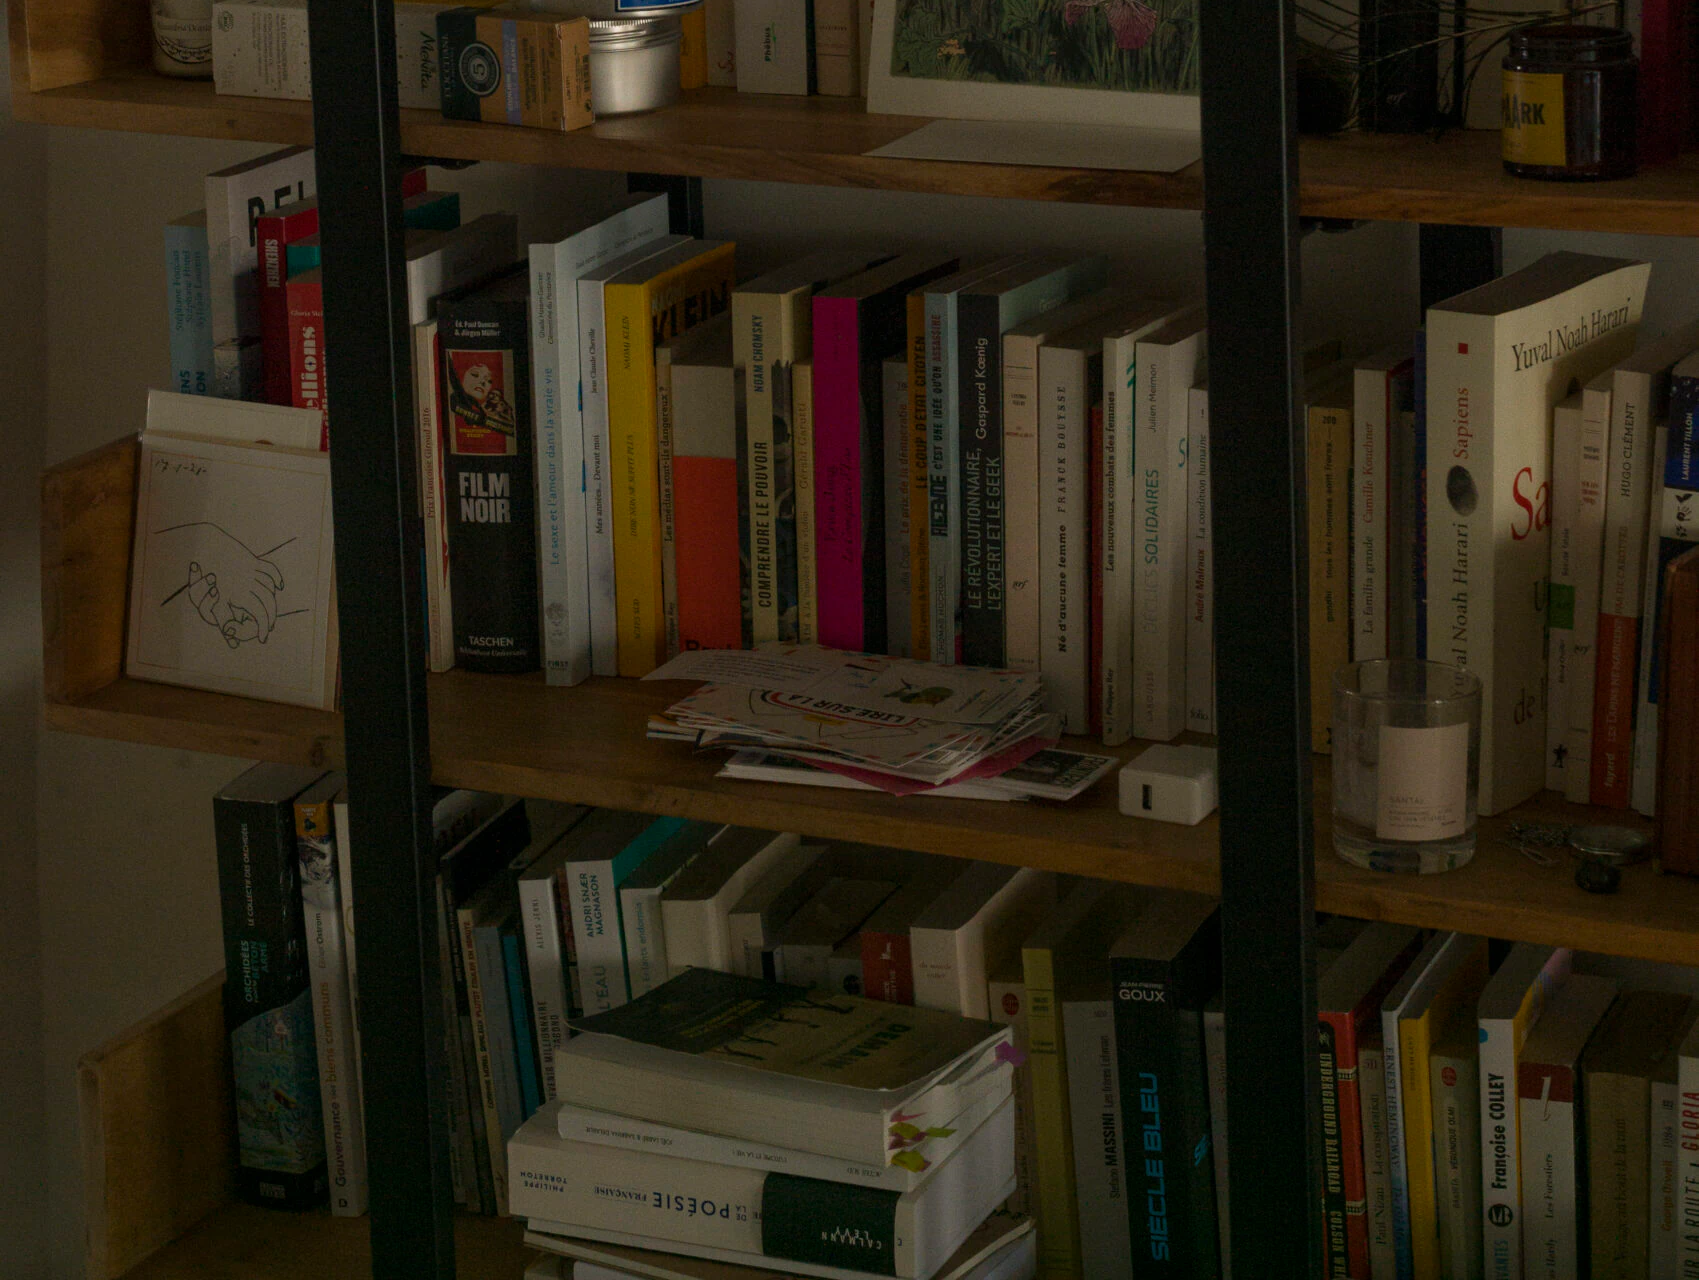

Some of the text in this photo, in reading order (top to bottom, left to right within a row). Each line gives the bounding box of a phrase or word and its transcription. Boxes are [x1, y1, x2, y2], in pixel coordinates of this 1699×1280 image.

[1512, 297, 1632, 372] Yuval Noah Harari
[542, 368, 553, 385] vie
[543, 387, 554, 416] vraie
[975, 382, 989, 439] Gaspard
[1148, 405, 1157, 433] Julien
[544, 418, 555, 429] la
[544, 432, 556, 458] dans
[752, 315, 772, 607] COMPRENDRE LE POUVOIR NOAM CHOMSKY
[1621, 403, 1635, 497] HUGO CLÉMENT
[1681, 413, 1693, 480] LAURENT TILLON
[459, 472, 510, 497] FILM
[660, 396, 672, 542] Les médias sont-ils dangereux
[1104, 392, 1115, 571] Les nouveaux combats des femmes
[461, 498, 511, 523] NOIR
[548, 510, 558, 522] et
[1056, 386, 1067, 652] Né d'aucune femme FRANCK BOUYSSE
[1145, 470, 1159, 564] SOLIDAIRES
[1362, 423, 1376, 633] La familia grande Camille Kouchner
[1451, 387, 1472, 642] Noah Harari Sapiens
[549, 524, 559, 547] sexe
[985, 457, 1002, 610] L'EXPERT ET LE GEEK
[548, 549, 560, 565] Le
[967, 591, 983, 608] LE
[468, 636, 513, 647] TASCHEN
[583, 906, 594, 937] ANDRI
[590, 875, 603, 935] MAGNASON
[1119, 988, 1166, 1002] GOUX
[1139, 1072, 1163, 1151] BLEU
[1319, 1052, 1336, 1134] UNDERGROUND
[1102, 1113, 1118, 1166] MASSINI
[1488, 1072, 1510, 1189] Françoise COLLEY
[520, 1170, 567, 1184] TORRETON
[523, 1180, 563, 1193] PHILIPPE
[1324, 1138, 1340, 1193] RAILROAD
[653, 1192, 729, 1219] POÉSIE
[820, 1230, 882, 1250] CALMANN
